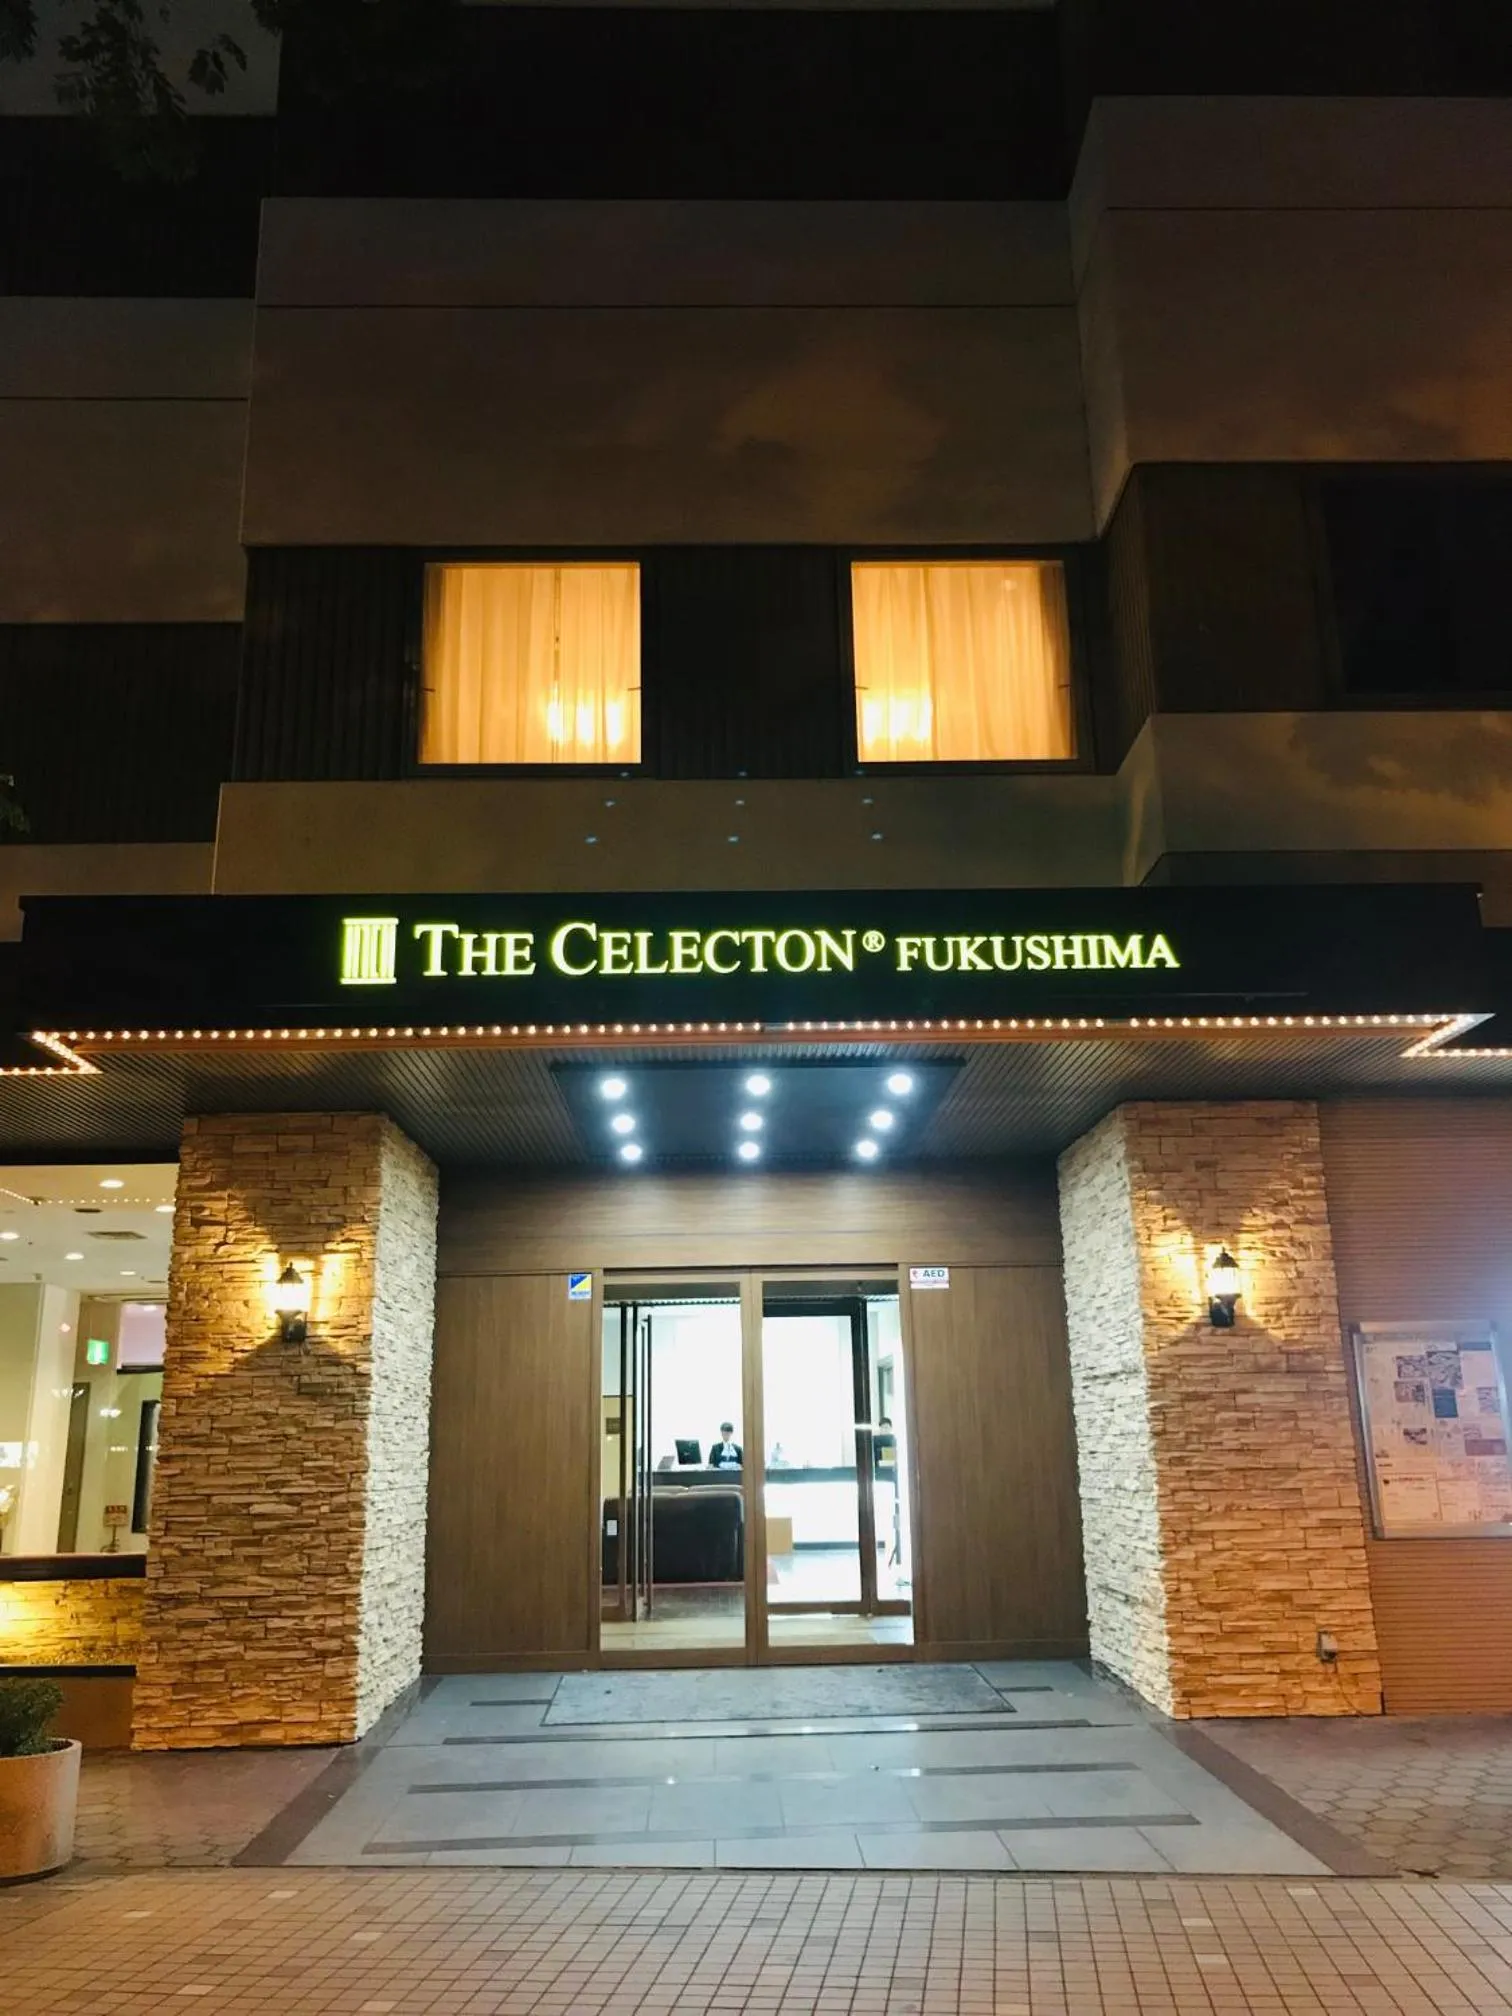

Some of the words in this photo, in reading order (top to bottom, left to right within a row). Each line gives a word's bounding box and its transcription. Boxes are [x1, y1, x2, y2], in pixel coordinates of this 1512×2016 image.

[413, 923, 537, 977] THE
[895, 934, 1181, 972] FUKUSHIMA
[923, 1269, 945, 1278] AED
